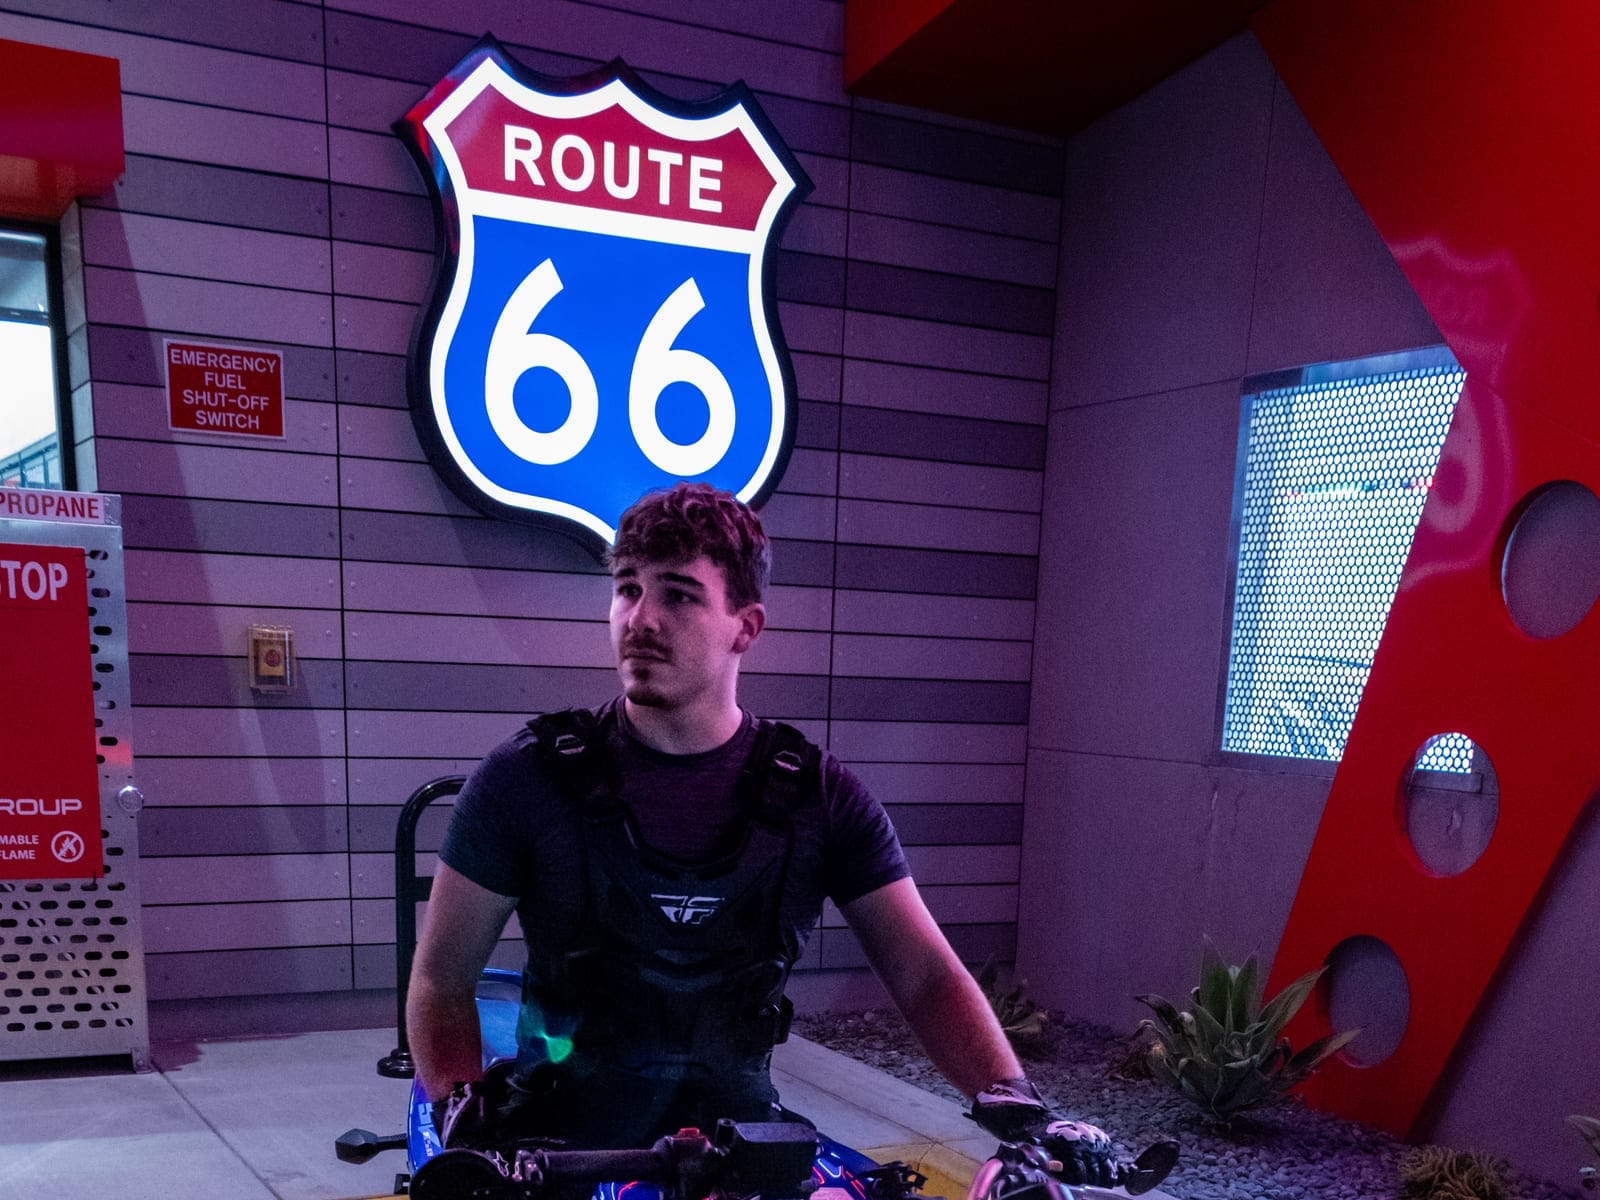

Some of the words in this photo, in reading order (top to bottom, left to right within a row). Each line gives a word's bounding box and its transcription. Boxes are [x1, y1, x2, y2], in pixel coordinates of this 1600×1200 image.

[503, 123, 723, 213] ROUTE
[170, 348, 277, 373] EMERGENCY
[484, 257, 736, 477] 66
[204, 371, 247, 390] FUEL
[182, 388, 270, 411] SHUT-OFF
[195, 409, 260, 430] SWITCH
[0, 560, 68, 601] TOP
